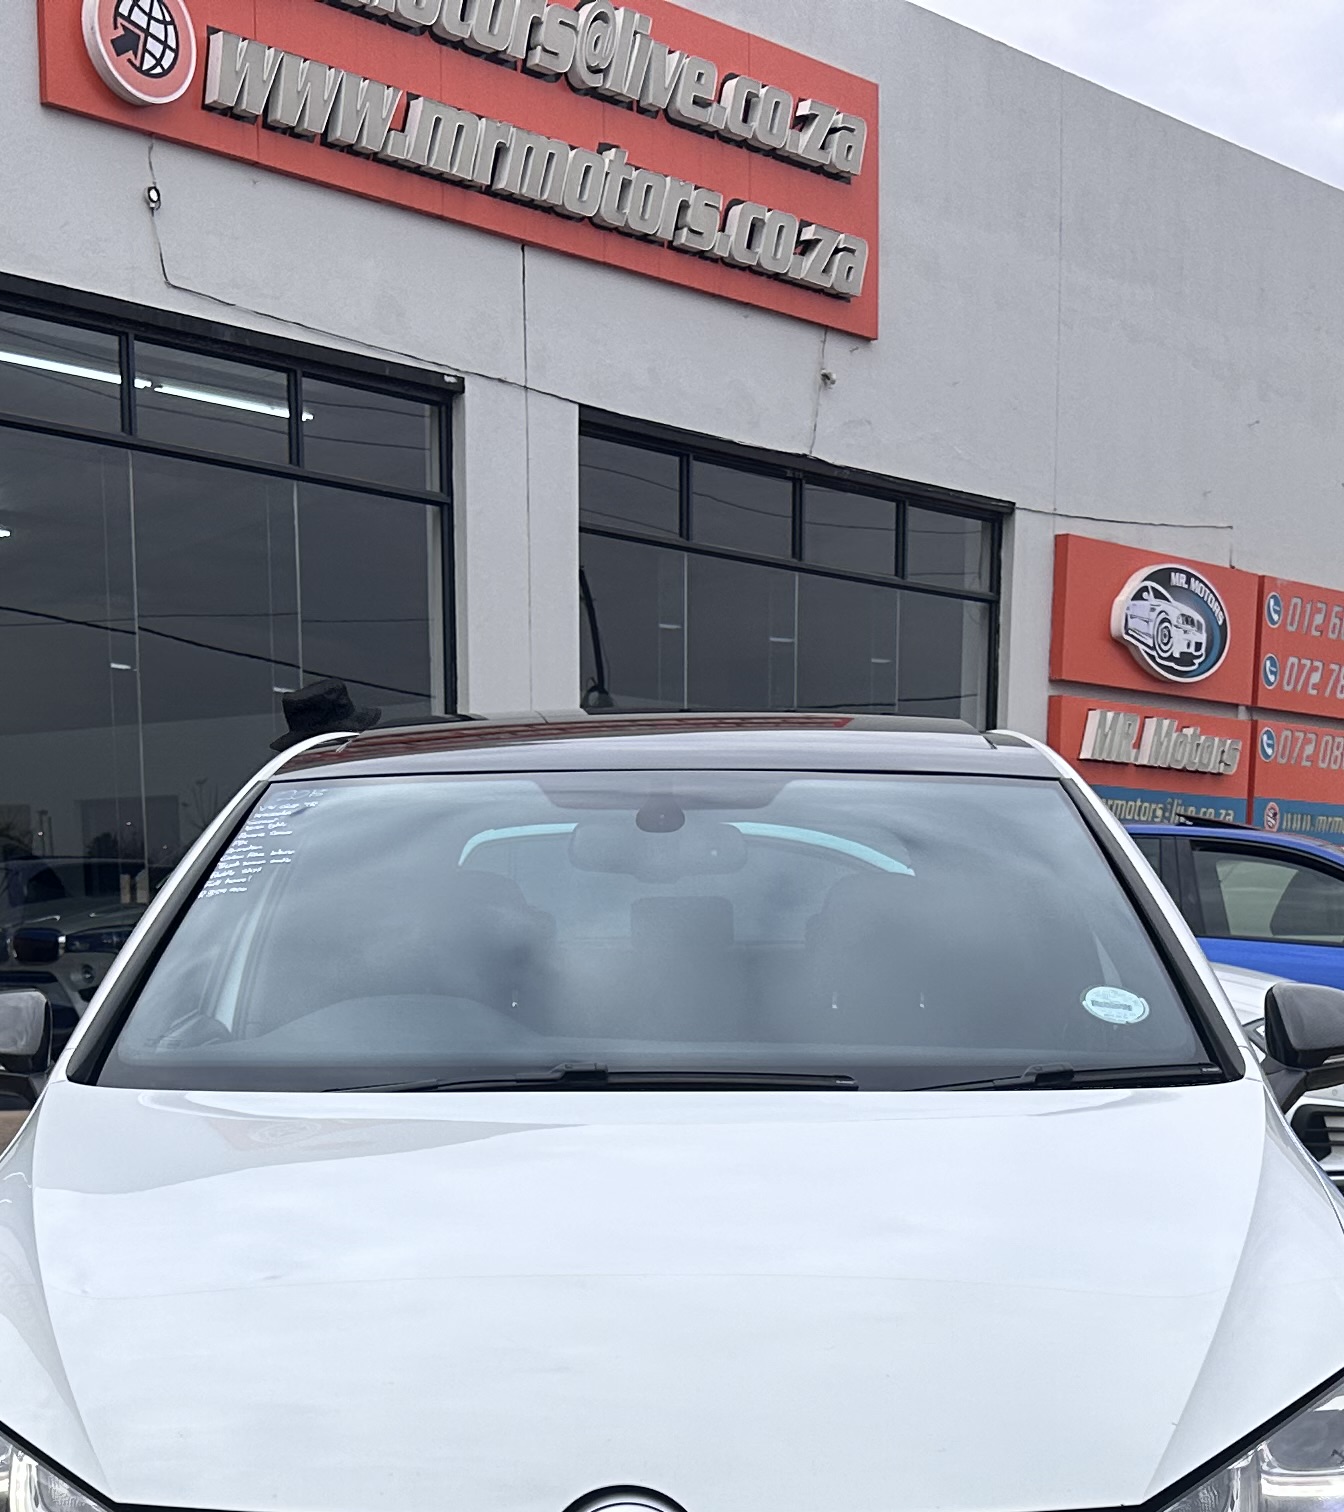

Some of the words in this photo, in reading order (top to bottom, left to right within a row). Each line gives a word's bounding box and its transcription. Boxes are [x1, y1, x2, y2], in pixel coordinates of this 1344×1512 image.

[341, 0, 867, 176] ors@live.co.za
[205, 30, 869, 297] www.mrmotors.co.za
[1170, 571, 1189, 589] MR.
[1189, 577, 1225, 626] MOTORS
[1286, 596, 1327, 637] 012
[1283, 656, 1324, 696] 072
[1079, 709, 1140, 763] MR.
[1138, 716, 1242, 775] Motors
[1277, 729, 1317, 768] 072
